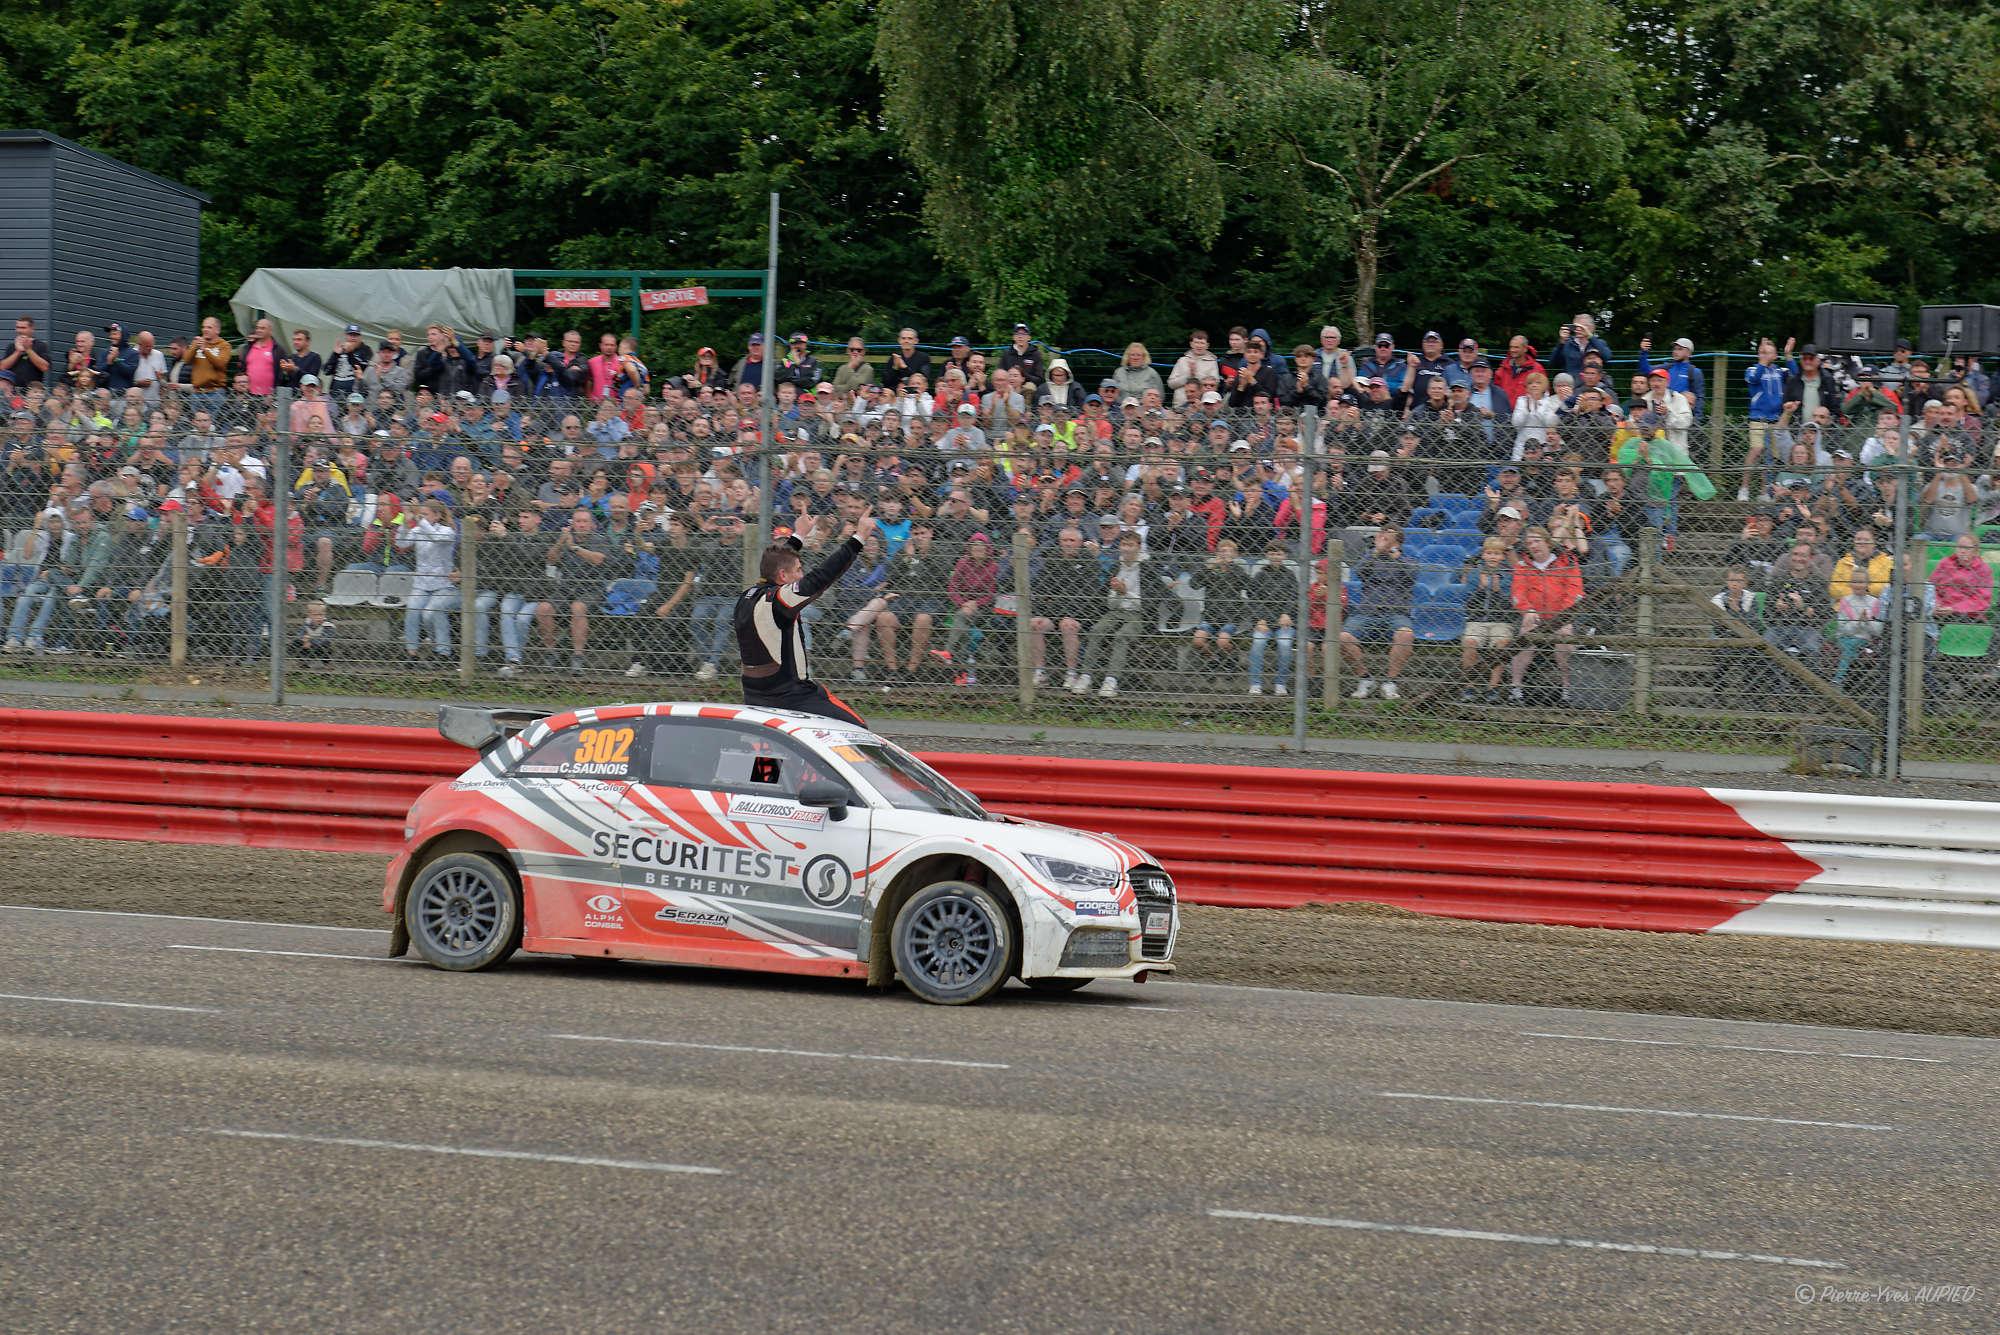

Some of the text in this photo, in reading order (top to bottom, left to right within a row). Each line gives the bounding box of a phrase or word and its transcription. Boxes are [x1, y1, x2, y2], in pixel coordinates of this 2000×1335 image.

[555, 291, 599, 301] SORTIE
[651, 290, 696, 303] SORTIE
[574, 728, 635, 763] 302
[559, 762, 628, 776] C.SAUNOIS
[578, 783, 625, 793] ArtColor
[735, 801, 795, 816] RALLYCROSS
[593, 831, 796, 881] SECURITEST
[645, 872, 750, 897] BETHENY
[1076, 902, 1119, 910] COOPER
[584, 913, 624, 922] ALPHA
[584, 920, 624, 930] CONSEIL
